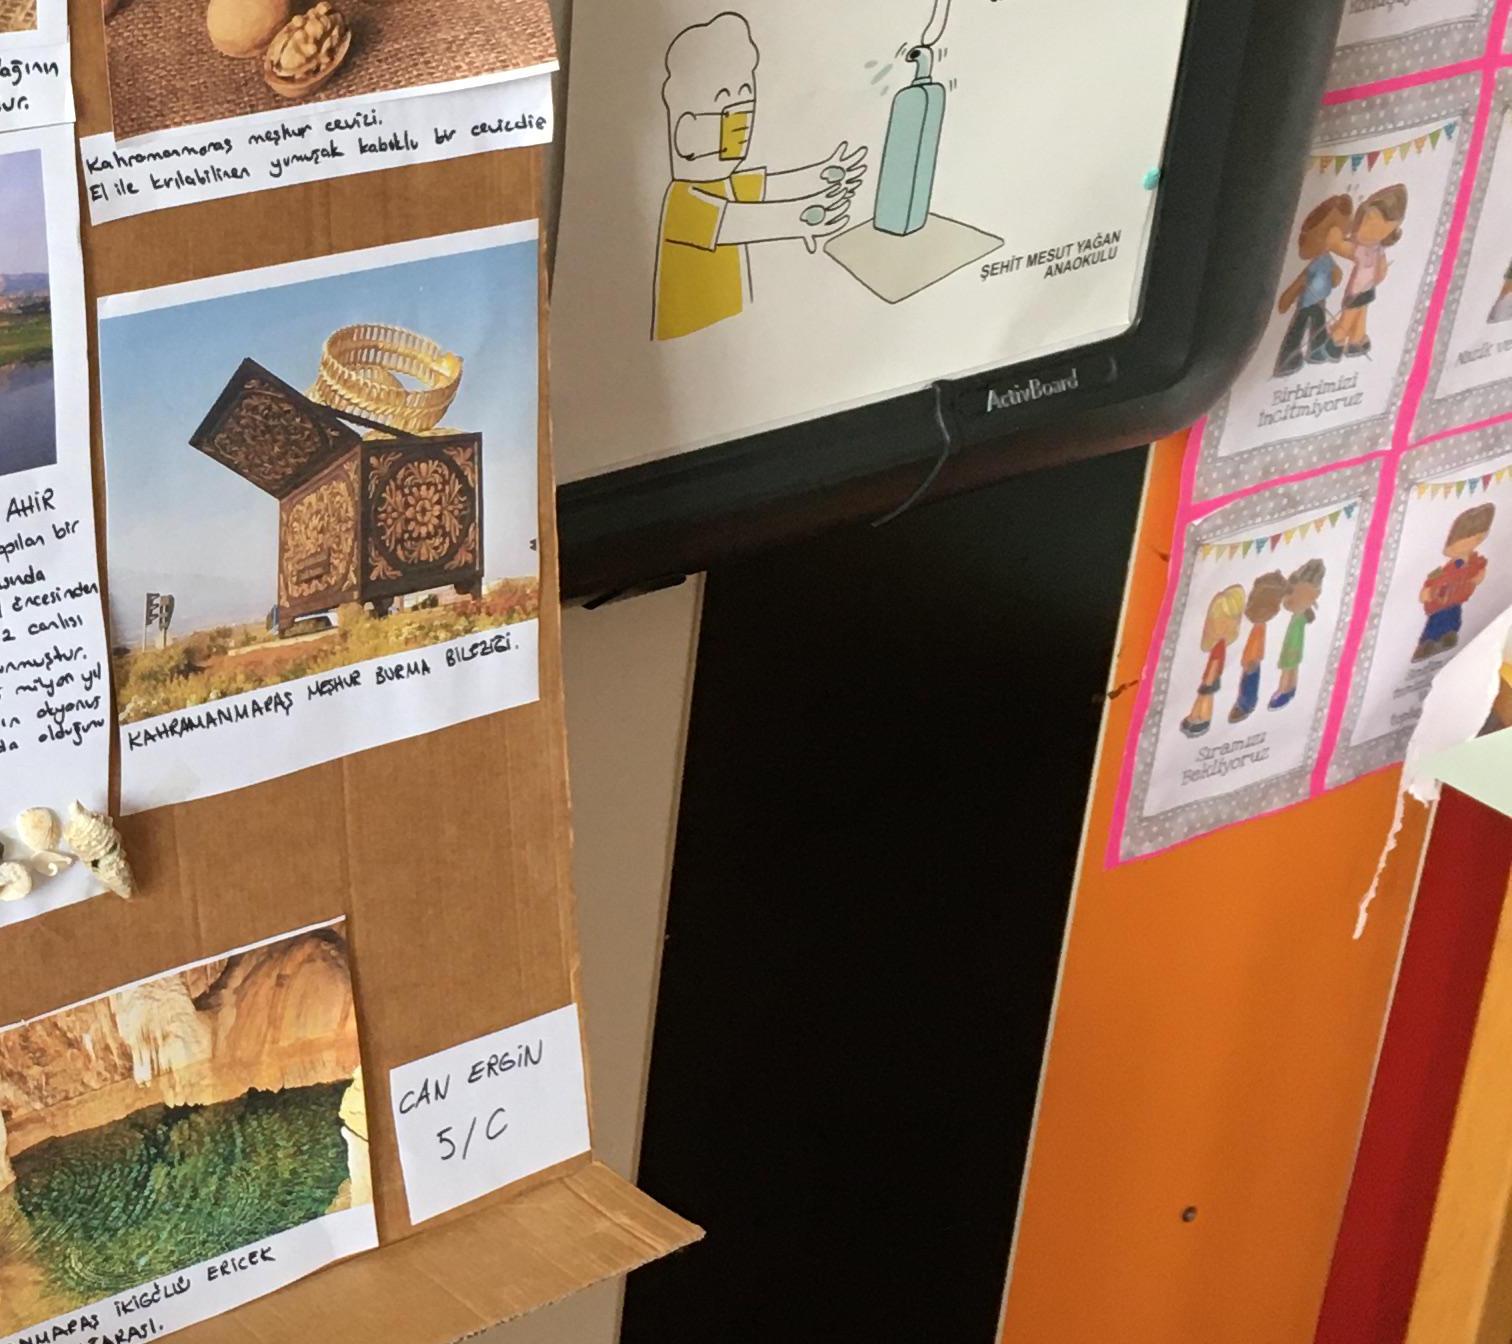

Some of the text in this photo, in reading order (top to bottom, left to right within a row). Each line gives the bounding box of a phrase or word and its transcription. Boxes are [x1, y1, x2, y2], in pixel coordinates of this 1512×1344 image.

[88, 182, 110, 203] El
[979, 229, 1123, 282] ŞEHİT MESUT YAĞAN
[1043, 247, 1119, 280] ANAOKULU
[987, 369, 1079, 412] ActivBoard
[51, 519, 80, 540] bir
[127, 658, 431, 752] KAHRAMANMARAŞ MEŞHUR BURMA
[398, 1039, 543, 1115] CAN ERGİN
